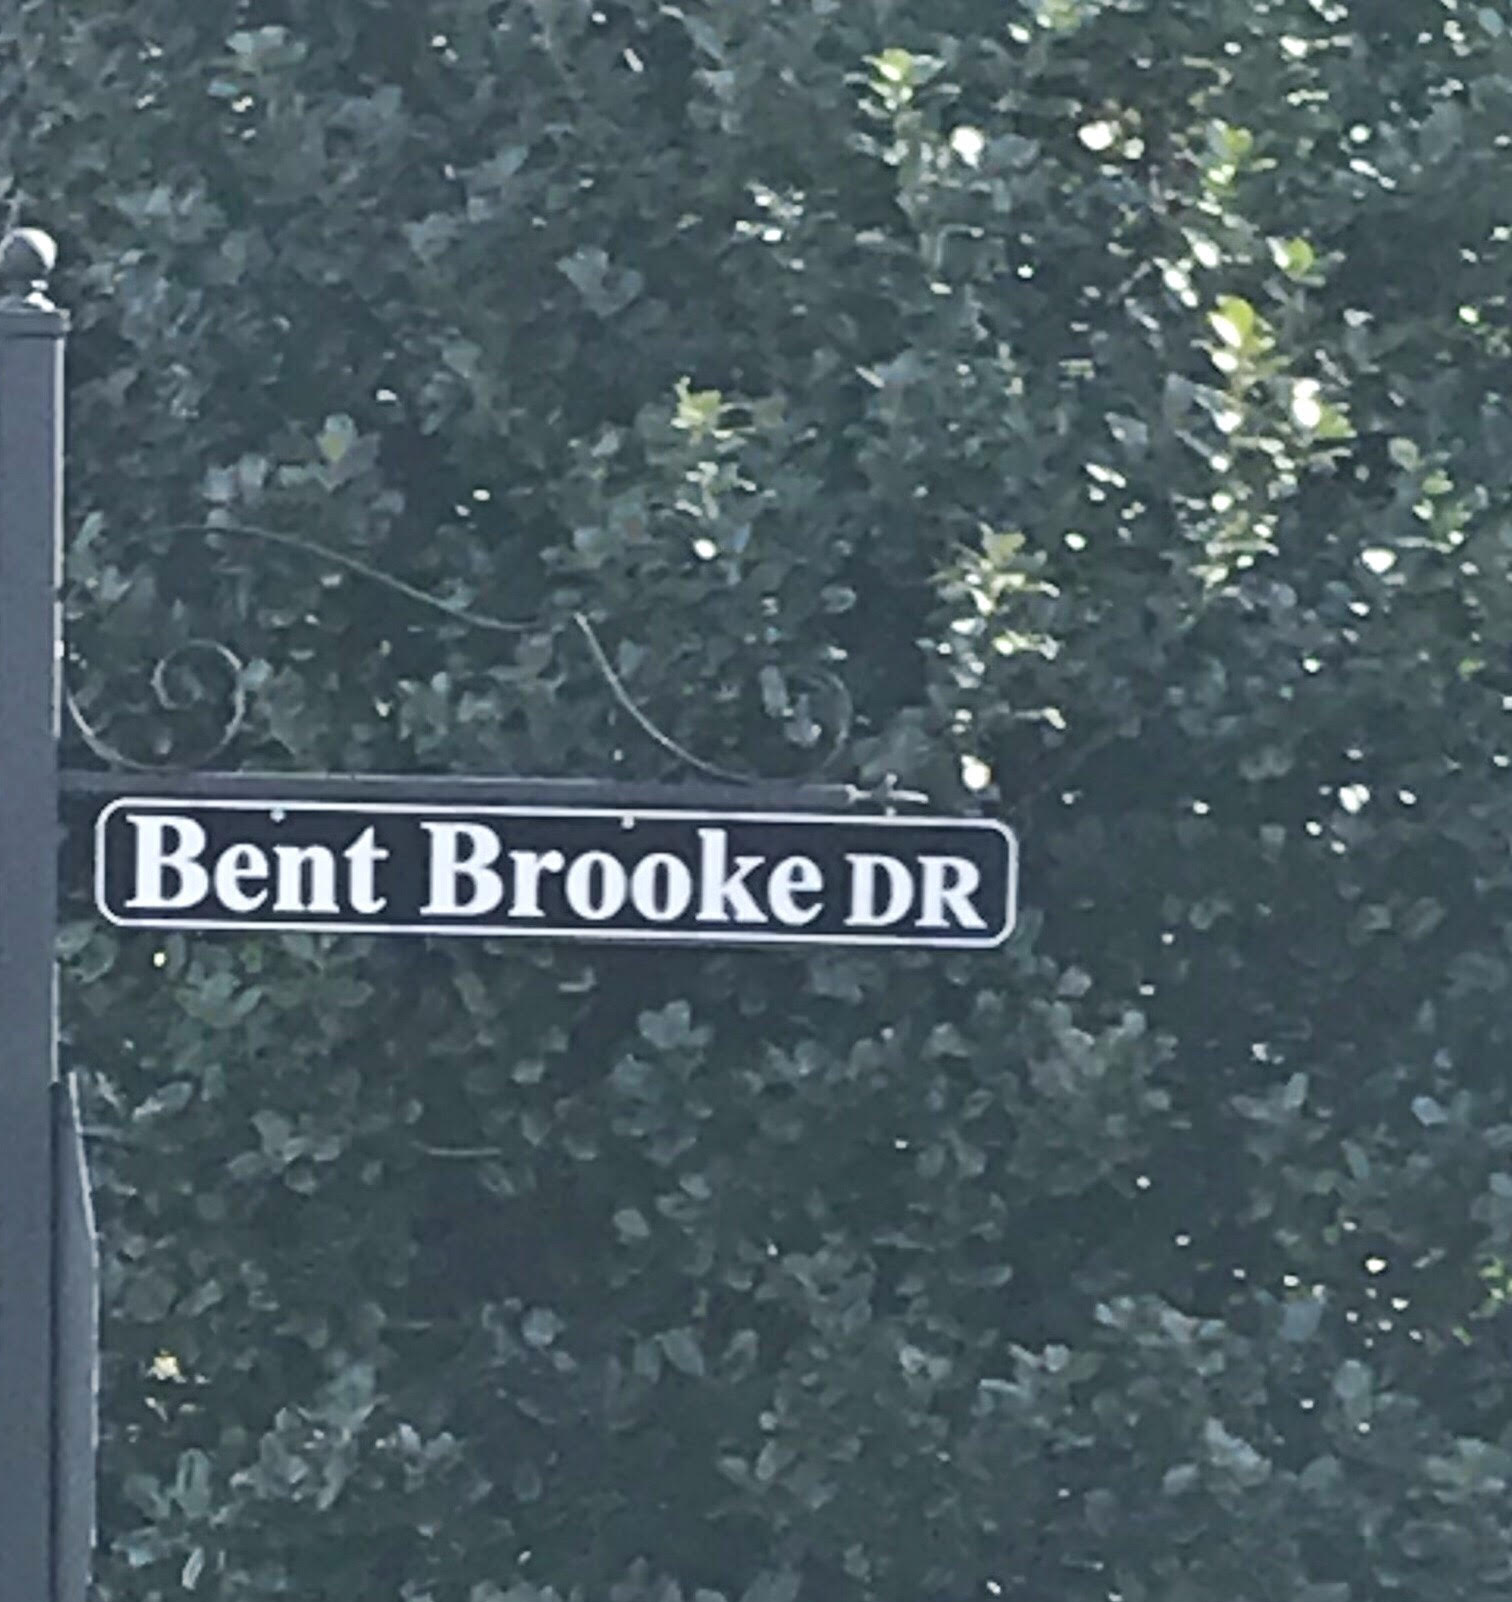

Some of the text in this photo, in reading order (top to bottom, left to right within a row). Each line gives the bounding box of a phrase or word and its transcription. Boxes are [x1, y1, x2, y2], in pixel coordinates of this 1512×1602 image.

[125, 814, 989, 930] Bent Brooke DR
